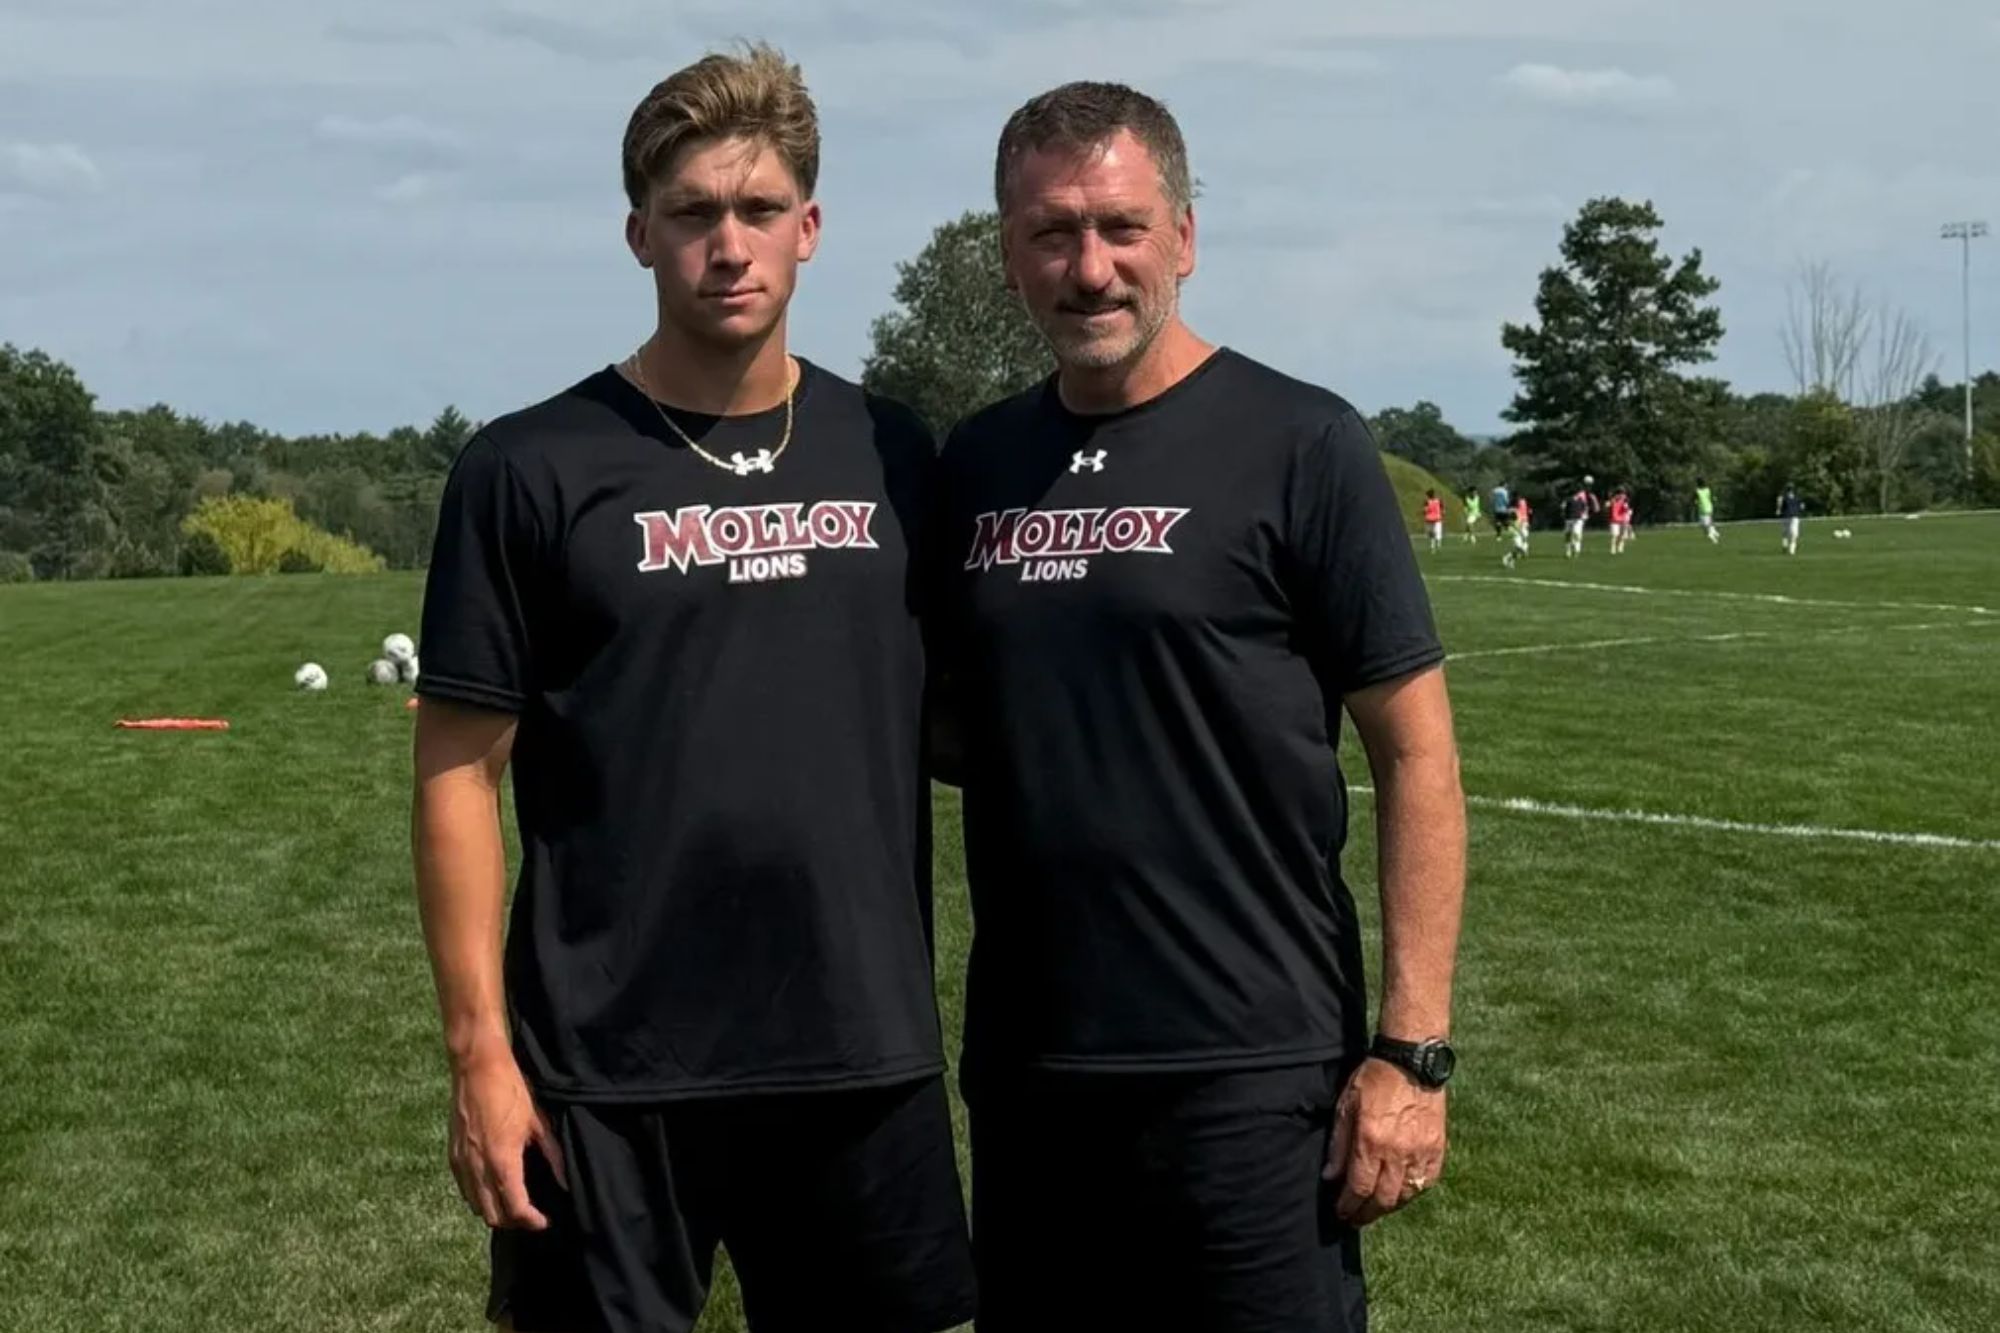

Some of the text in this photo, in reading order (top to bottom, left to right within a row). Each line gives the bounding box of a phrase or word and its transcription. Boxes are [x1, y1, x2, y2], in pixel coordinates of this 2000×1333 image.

[634, 502, 880, 574] MOLLOY
[964, 506, 1192, 572] MOLLOY
[728, 553, 808, 583] LIONS
[1019, 557, 1088, 583] LIONS
